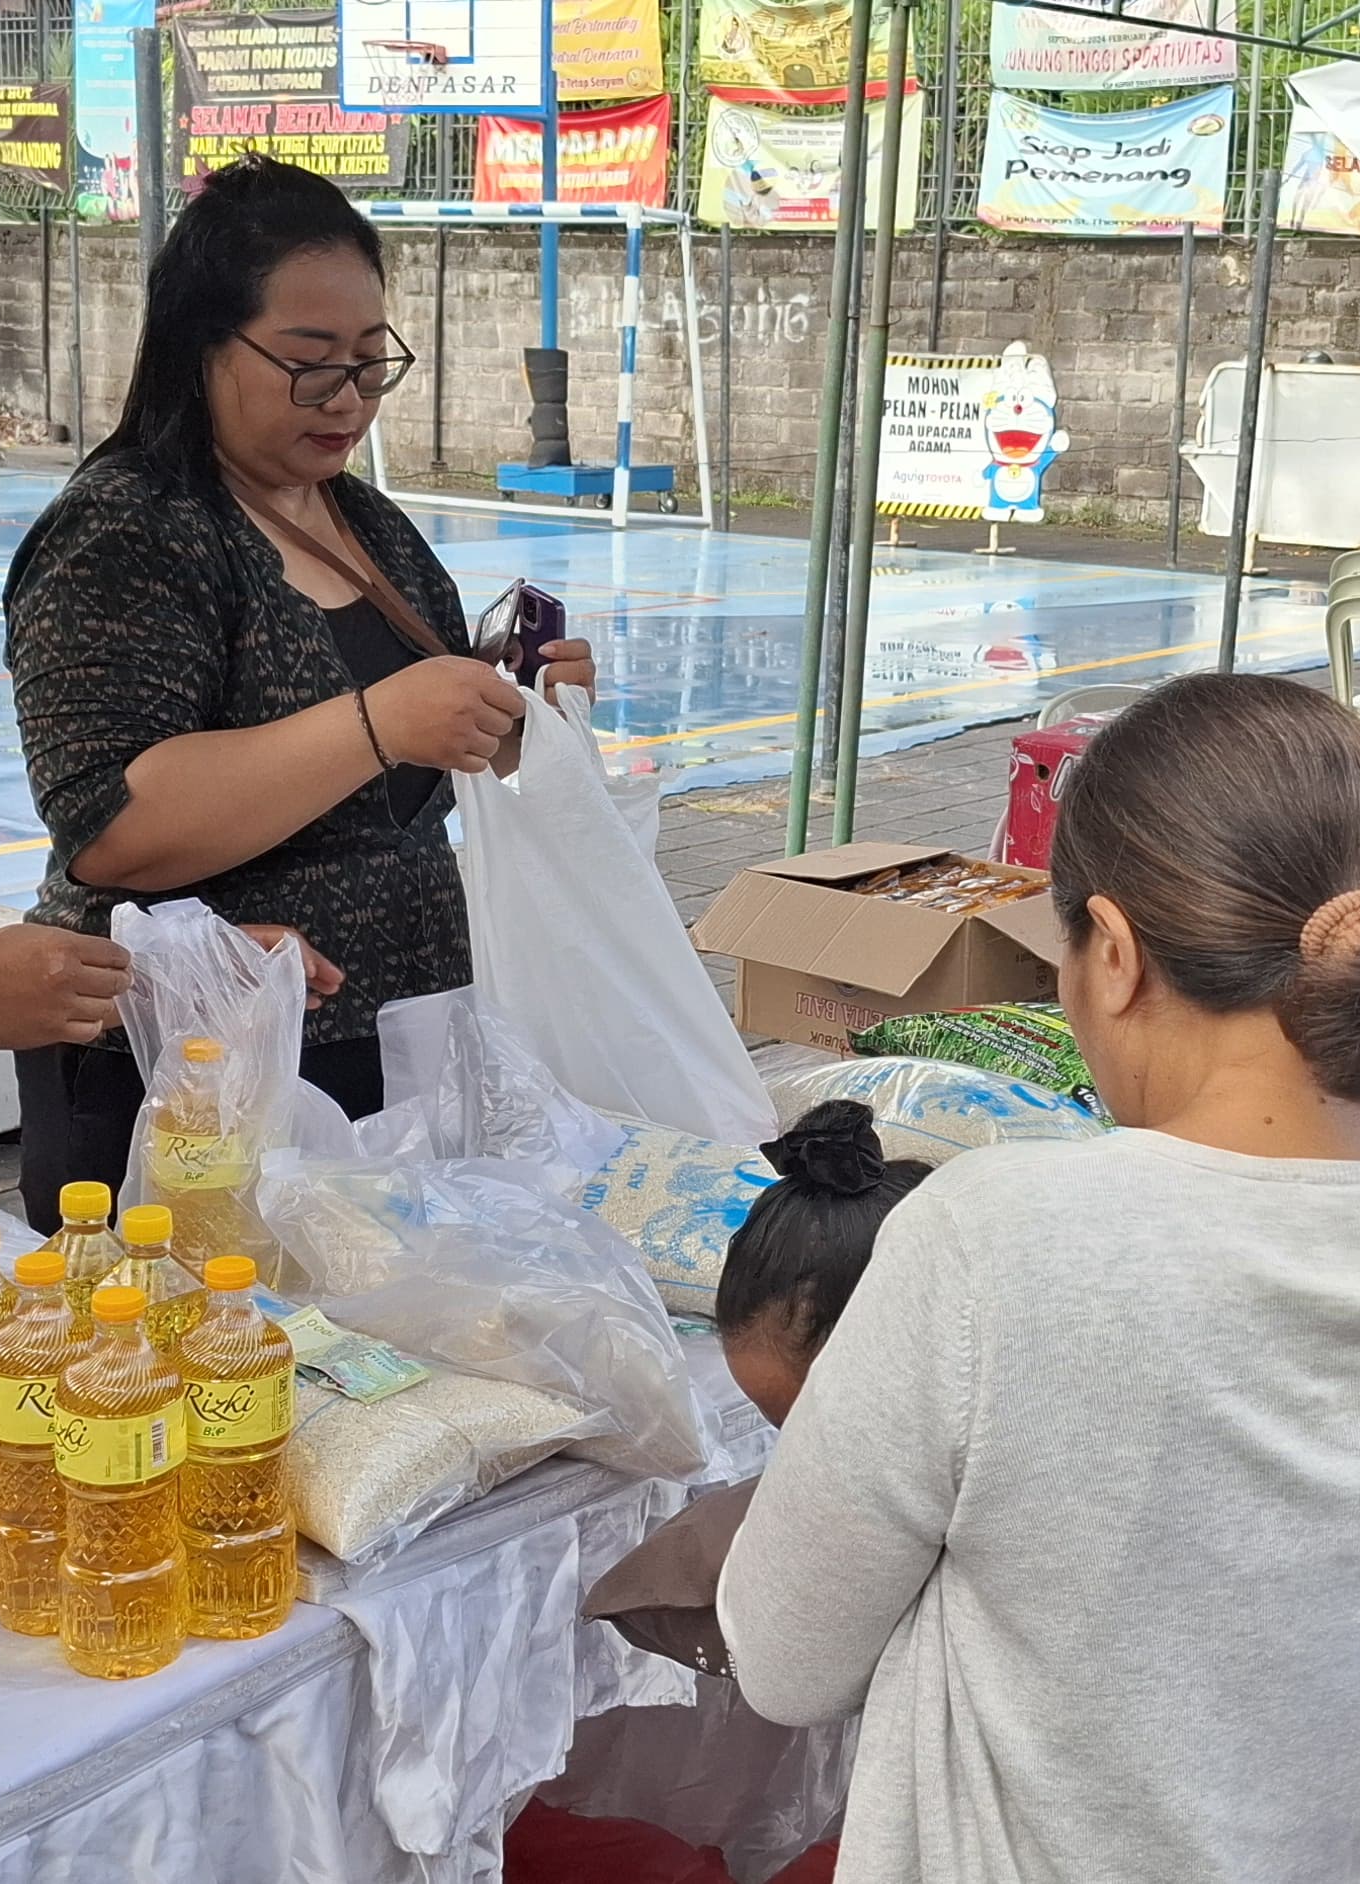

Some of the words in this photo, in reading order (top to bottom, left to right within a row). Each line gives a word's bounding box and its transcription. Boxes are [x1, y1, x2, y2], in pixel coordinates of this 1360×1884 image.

[188, 28, 238, 46] SELAMAT
[240, 27, 277, 45] ULANG
[197, 50, 250, 71] PAROKI
[252, 49, 283, 69] ROH
[284, 47, 338, 69] KUDUS
[1067, 49, 1116, 72] TINGGI
[1121, 40, 1223, 71] SPORTIVITAS
[208, 75, 261, 92] KATEDRAL
[262, 72, 323, 90] DENPASAR
[368, 76, 516, 94] DENPASAR
[191, 104, 272, 135] SELAMAT
[1019, 135, 1091, 164] Siap
[1101, 138, 1172, 160] Jadi
[1005, 160, 1192, 188] Pemenang
[907, 376, 960, 396] MOHON
[882, 399, 927, 419] PELAN
[939, 402, 980, 421] PELAN
[889, 424, 913, 437] ADA
[917, 424, 972, 440] UPACARA
[908, 440, 951, 454] AGAMA
[795, 991, 838, 1023] BALI
[842, 1002, 895, 1030] ETIA
[184, 1382, 259, 1425] Rizki
